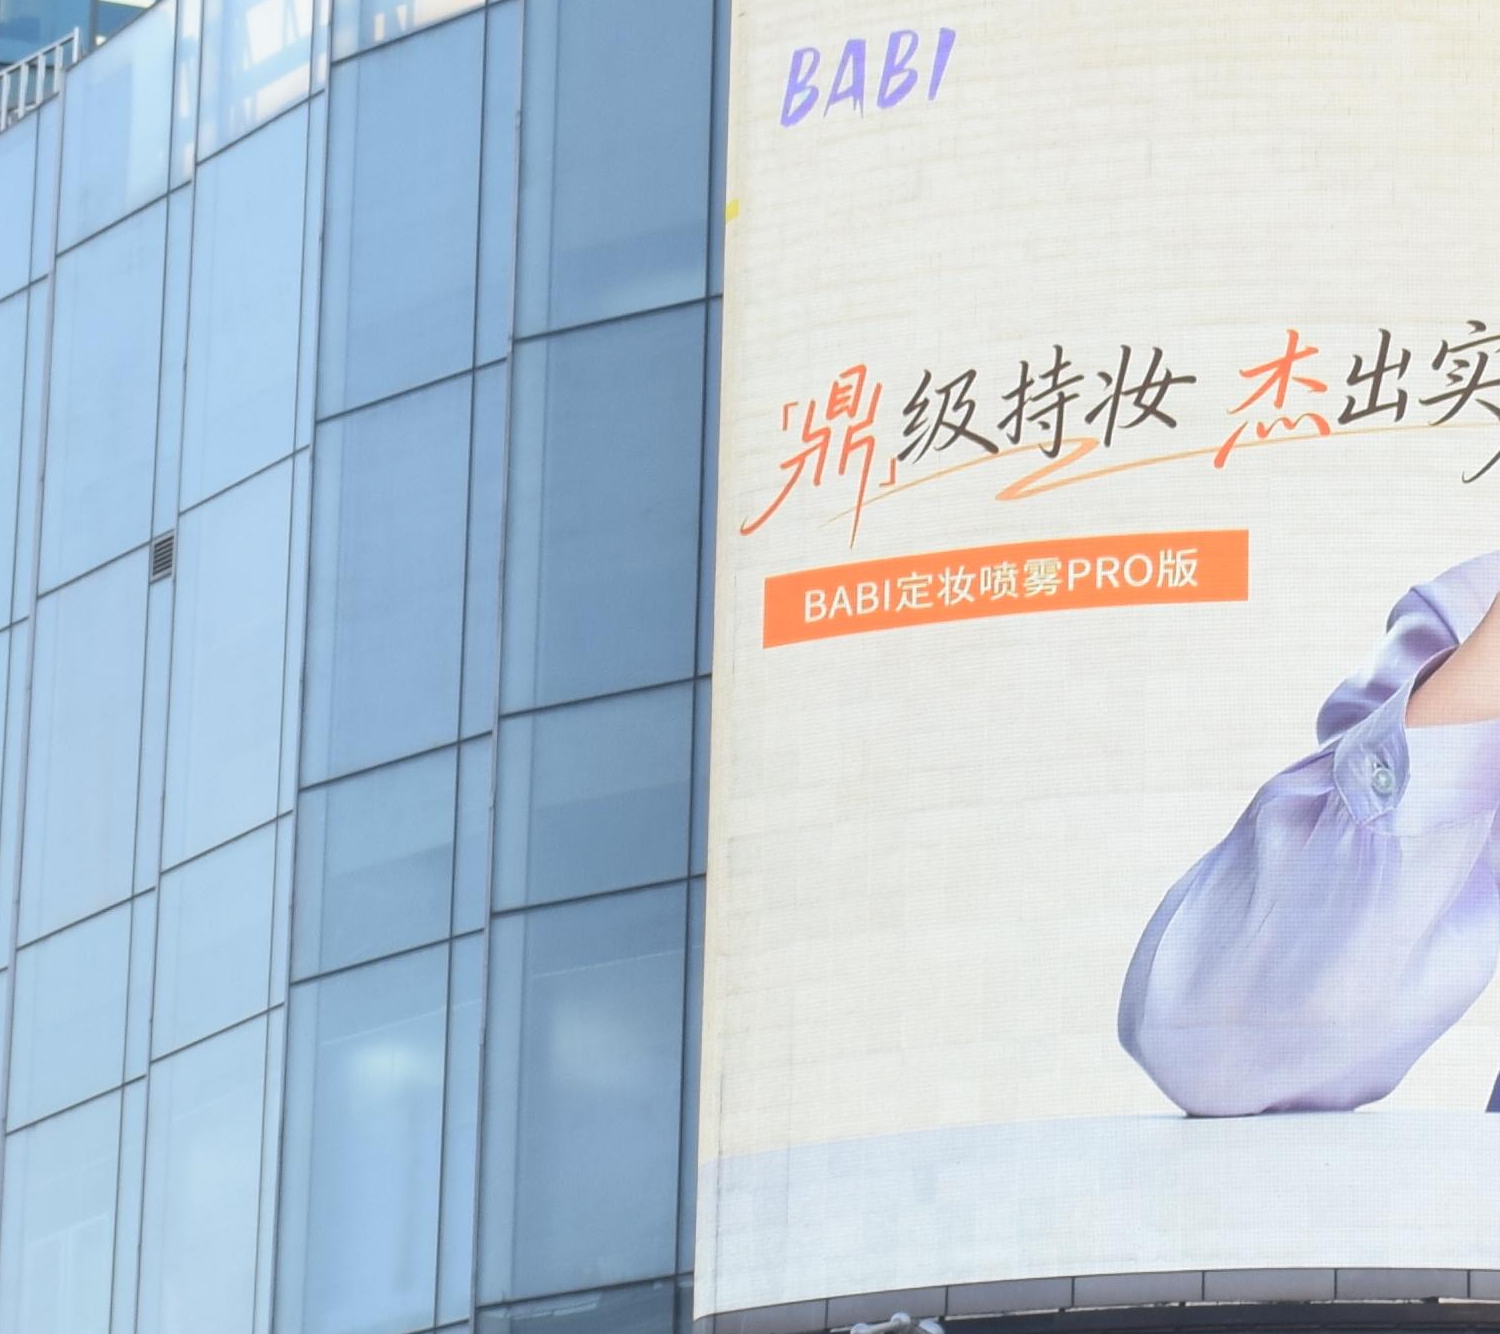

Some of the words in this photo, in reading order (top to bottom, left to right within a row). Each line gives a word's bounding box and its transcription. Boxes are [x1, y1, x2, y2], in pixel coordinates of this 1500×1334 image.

[780, 27, 956, 128] BABI
[803, 547, 1199, 623] BABI定妆喷雾PRO版
